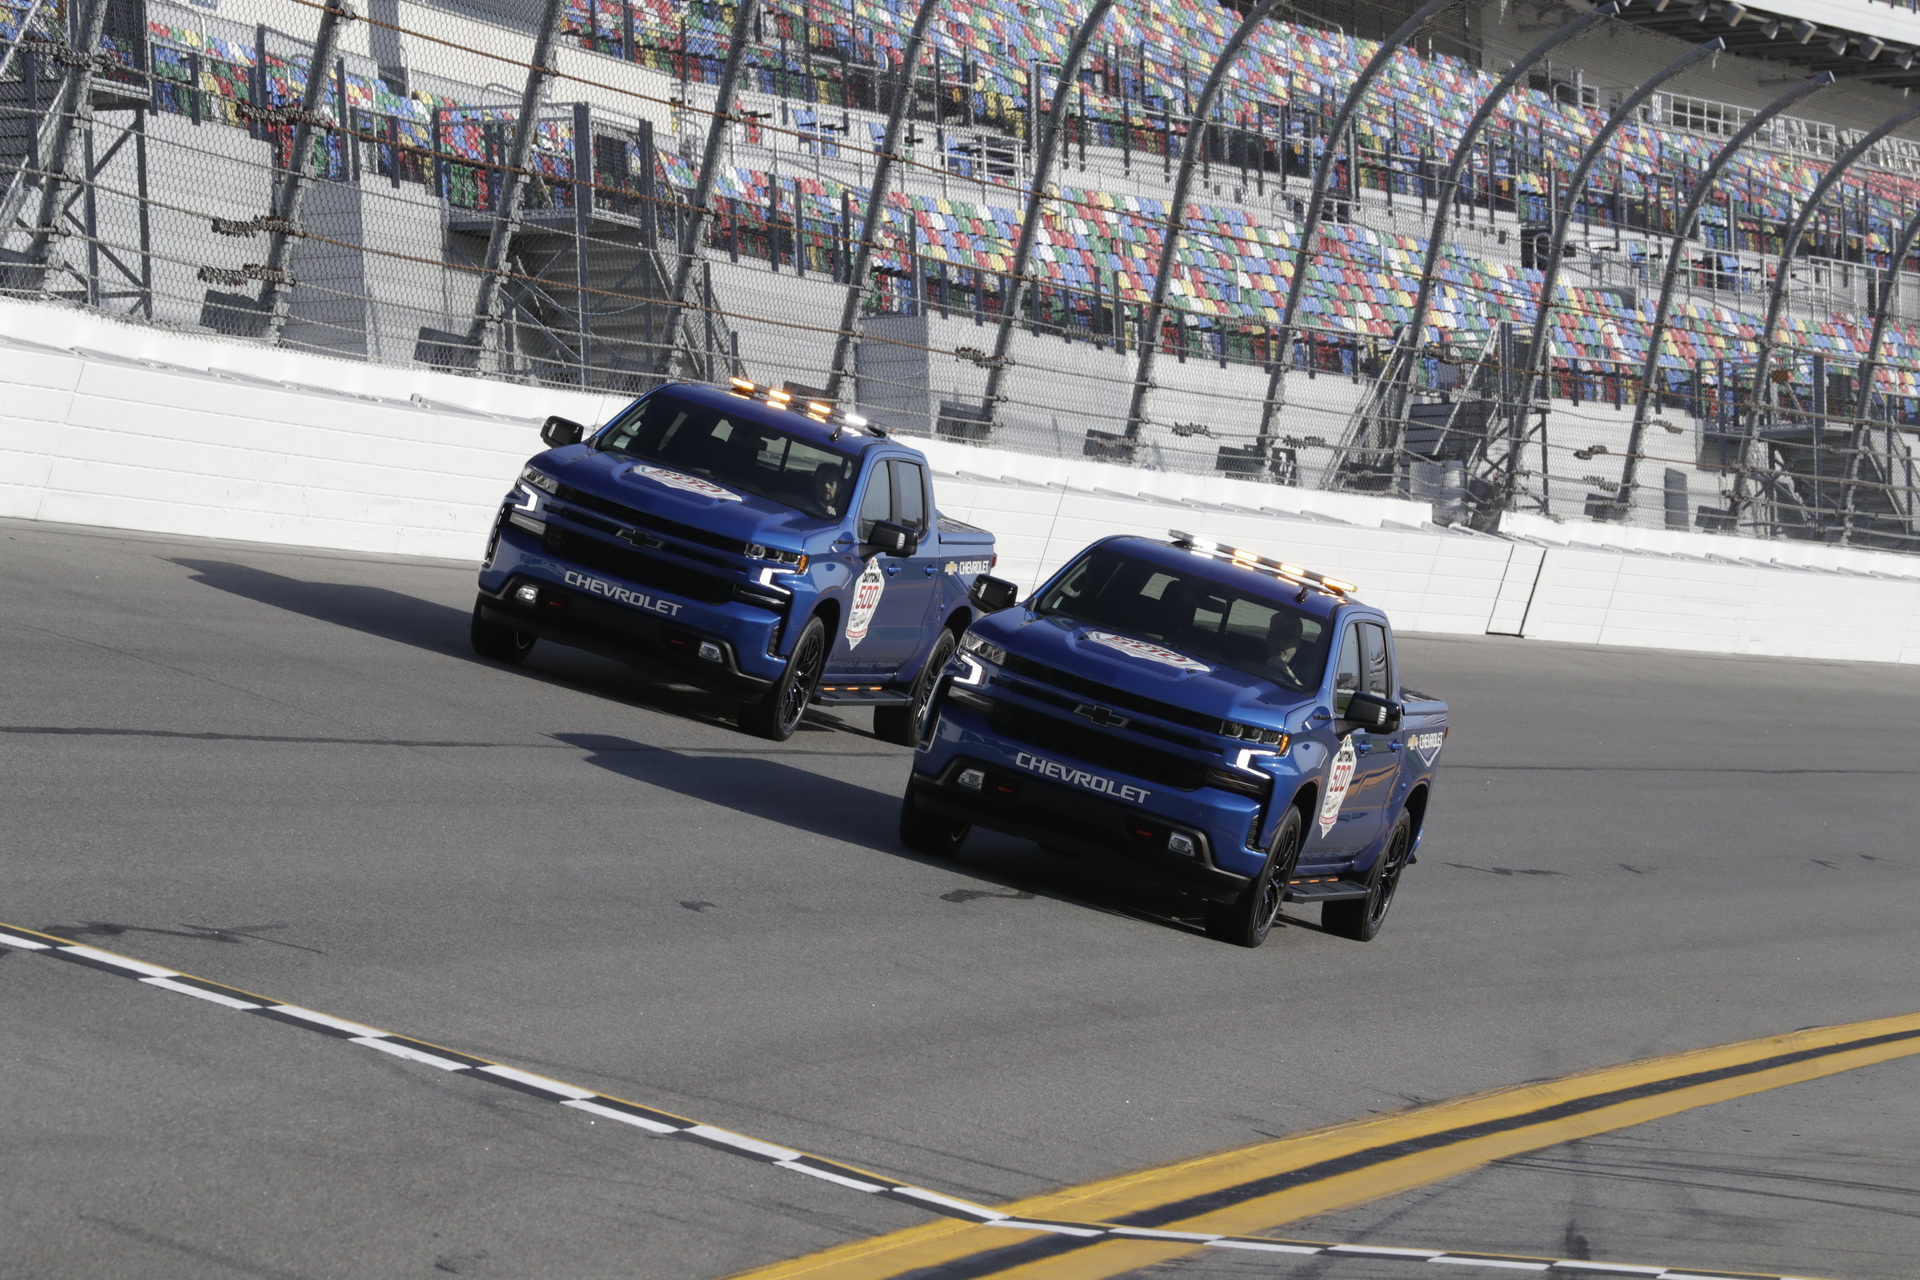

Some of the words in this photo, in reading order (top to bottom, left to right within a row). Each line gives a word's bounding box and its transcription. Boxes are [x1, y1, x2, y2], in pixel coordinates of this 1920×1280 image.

[959, 560, 990, 575] CHEVROLET
[564, 570, 683, 617] CHEVROLET
[856, 585, 879, 609] 500
[1015, 751, 1152, 804] CHEVROLET
[1330, 765, 1352, 792] 500
